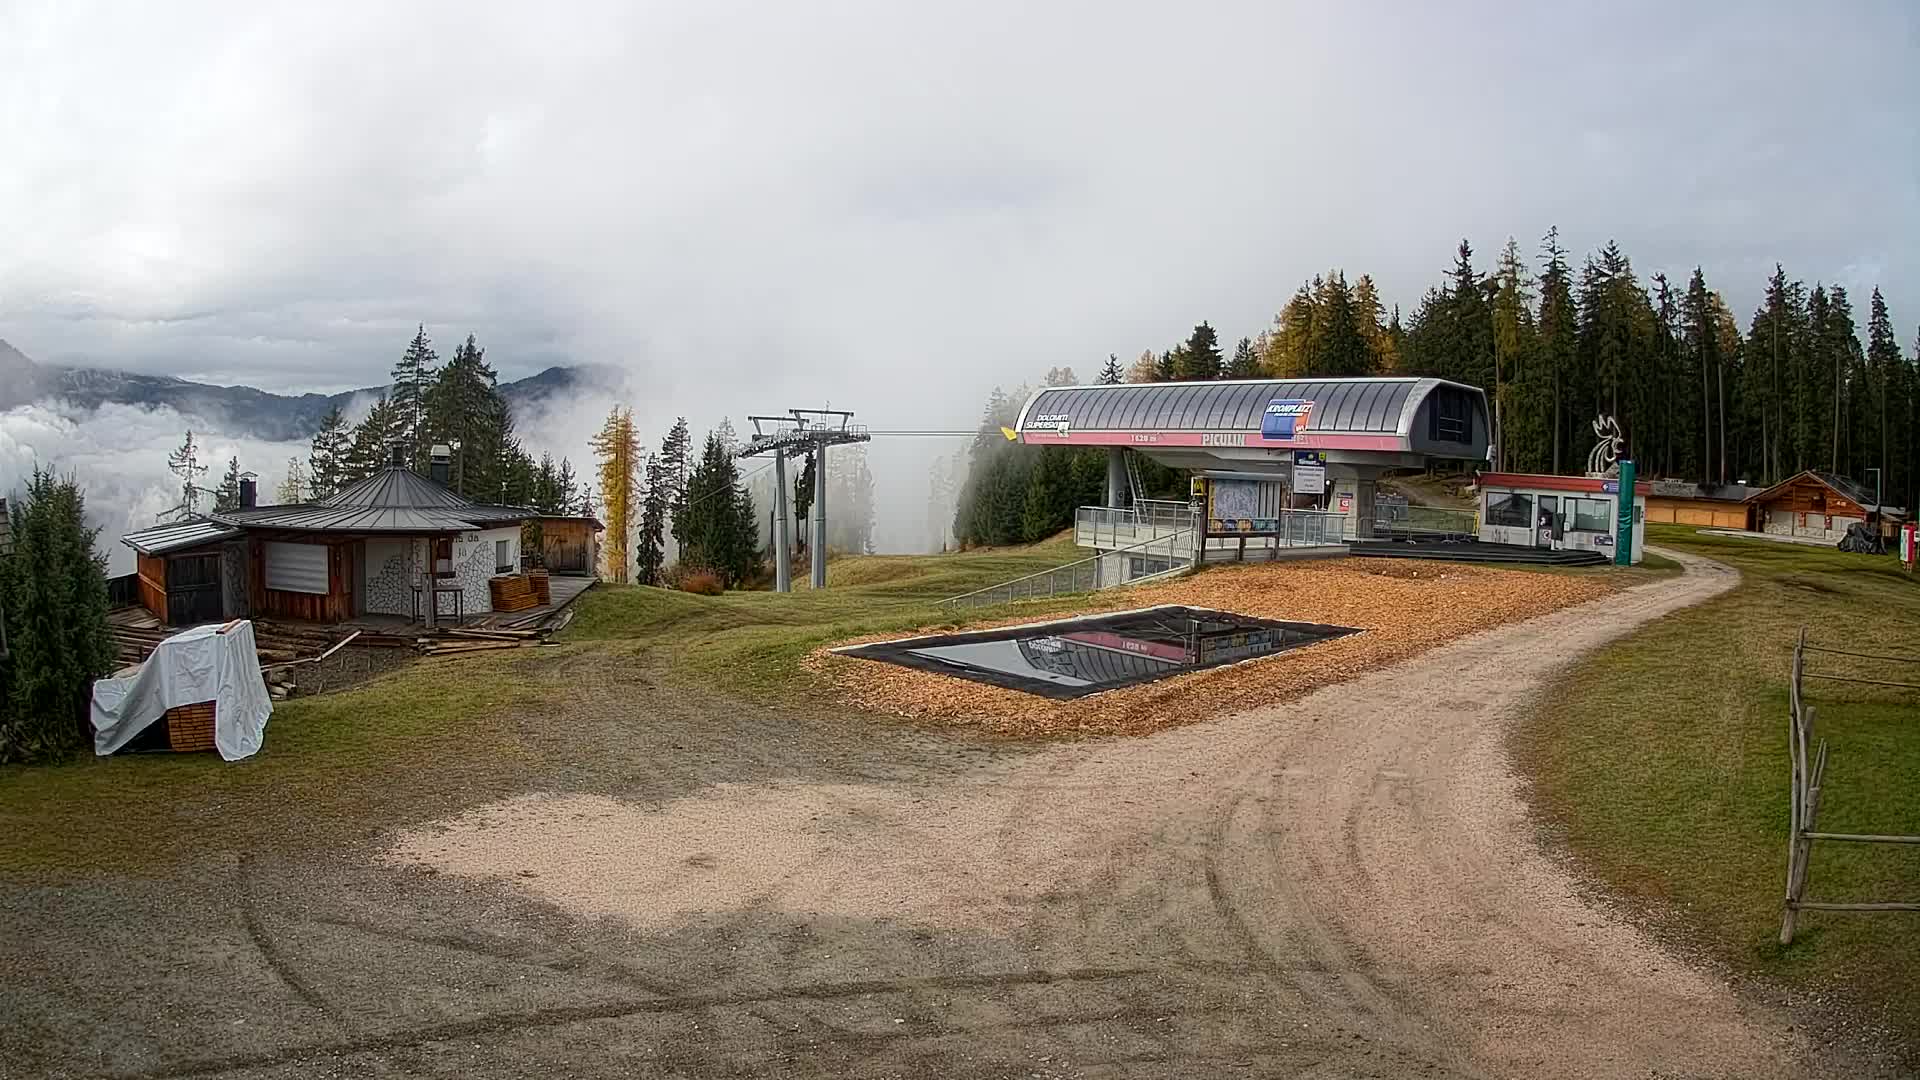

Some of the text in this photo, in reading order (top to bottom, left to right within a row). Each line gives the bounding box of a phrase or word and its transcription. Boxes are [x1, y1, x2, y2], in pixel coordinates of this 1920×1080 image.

[1266, 404, 1312, 413] KRONPLATZ
[1026, 421, 1058, 429] SUPERSKI
[1202, 433, 1246, 446] PICULIN
